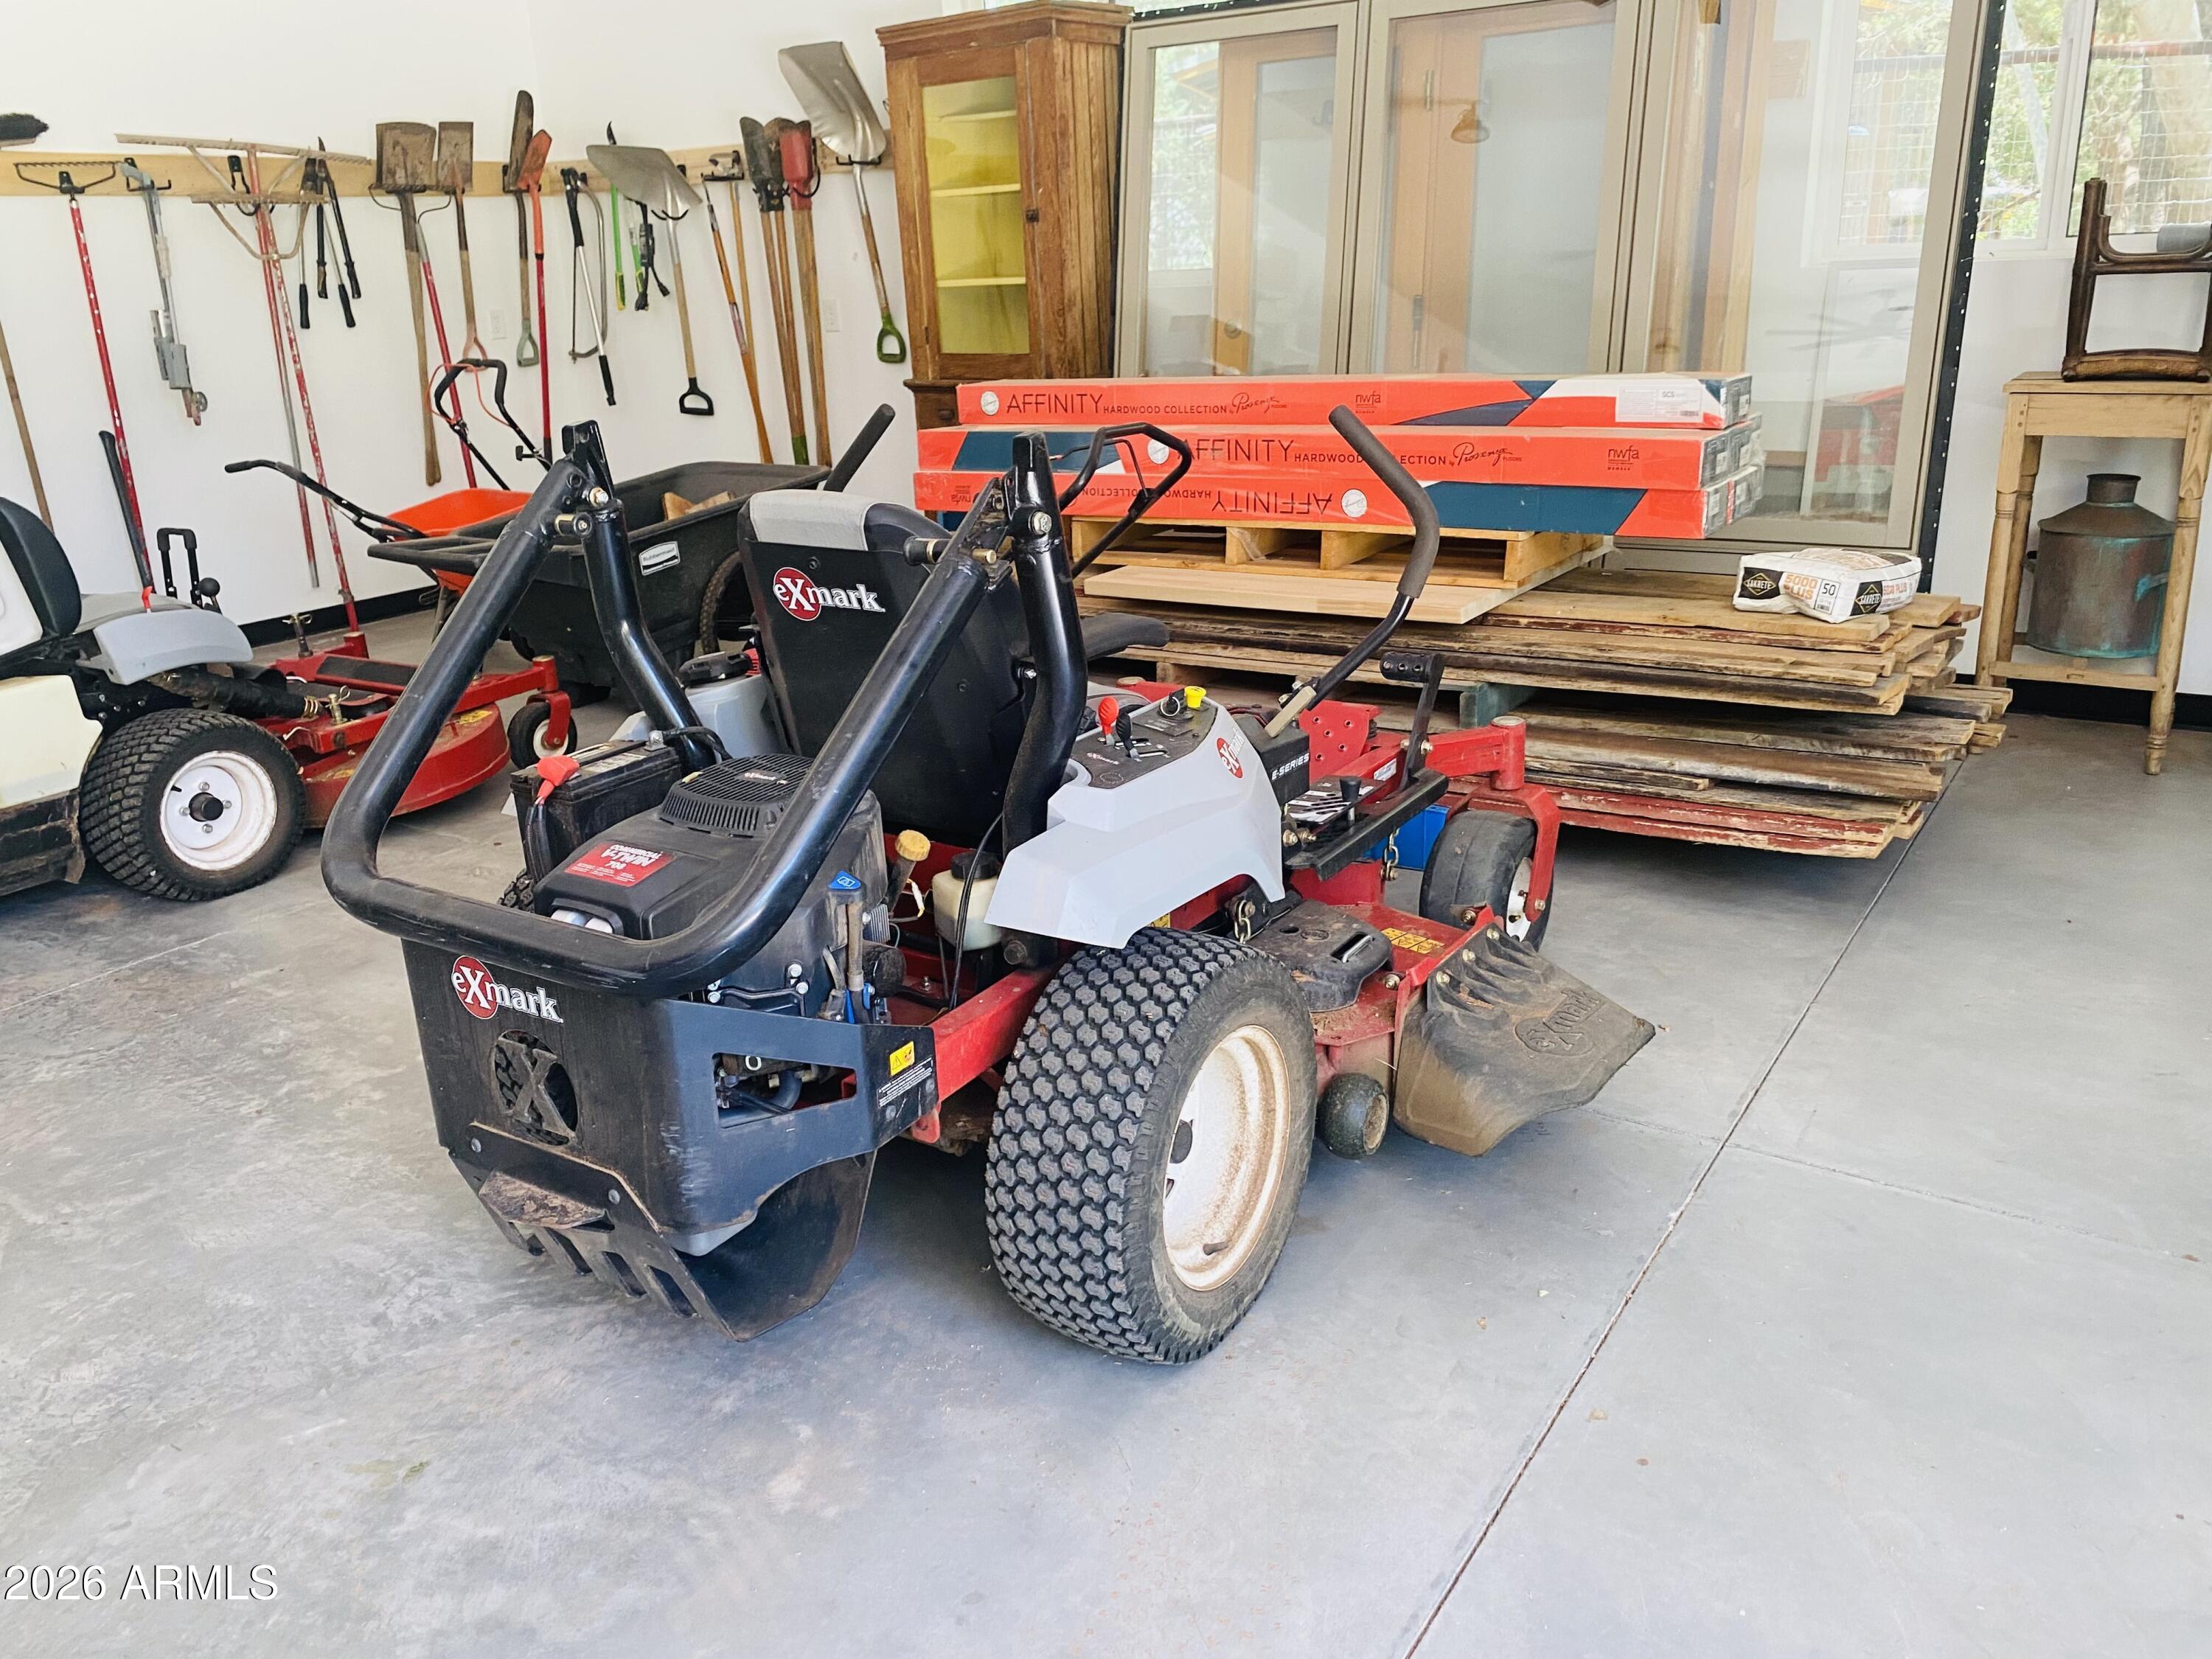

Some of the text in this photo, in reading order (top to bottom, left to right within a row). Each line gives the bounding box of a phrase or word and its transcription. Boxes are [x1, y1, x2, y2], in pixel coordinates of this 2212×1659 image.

[1006, 393, 1103, 414] AFFINITY
[1103, 405, 1161, 414] HARDWOOD
[1164, 405, 1227, 414] COLLECTION
[1294, 453, 1363, 463] HARDWOOD
[1608, 445, 1640, 462] nwfa
[1082, 487, 1332, 515] AFFINITY HARDWO OLLECTION
[1785, 574, 1818, 589] 5000
[1821, 582, 1837, 596] 50
[1271, 752, 1310, 781] E-SERIES
